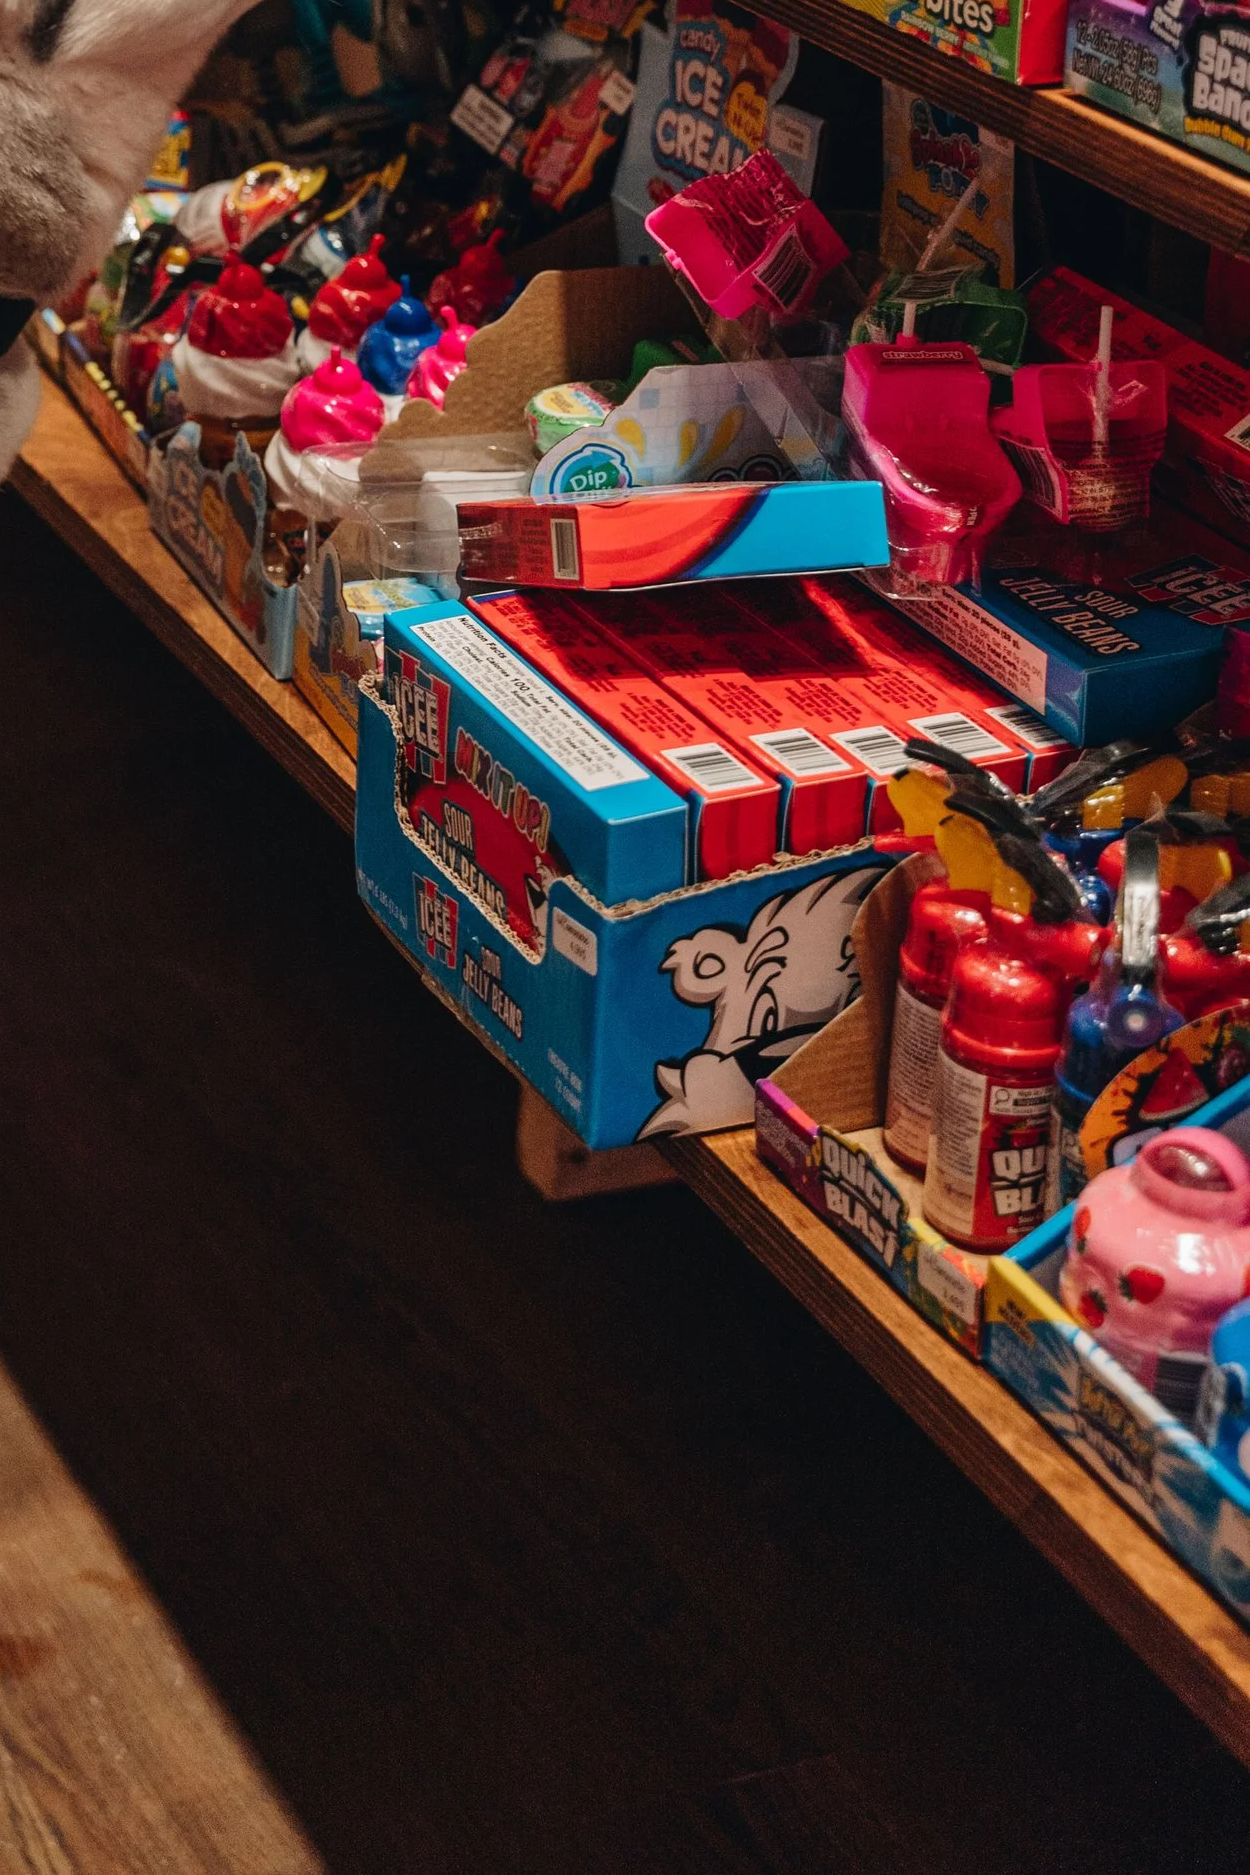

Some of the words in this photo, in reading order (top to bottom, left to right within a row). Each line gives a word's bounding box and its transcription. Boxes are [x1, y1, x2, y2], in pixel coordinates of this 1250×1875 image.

[680, 29, 721, 62] candy
[1198, 35, 1250, 91] Spa
[675, 59, 723, 119] ICE
[883, 351, 964, 360] strawberry
[570, 470, 607, 491] Dip
[1000, 576, 1078, 612] JELLY
[1051, 610, 1141, 654] BEANS
[1074, 590, 1139, 618] SOUR
[416, 625, 438, 641] Protein
[457, 617, 490, 642] Nutrition
[485, 642, 509, 658] Facts
[985, 642, 1002, 660] Total
[484, 656, 513, 677] Calories
[393, 671, 441, 757] ICEE
[453, 725, 493, 802] MIX
[492, 759, 516, 820] IT
[513, 780, 551, 855] UP!
[443, 801, 473, 853] SOUR
[419, 891, 452, 948] ICEE
[463, 954, 490, 1002] JELLY
[491, 985, 523, 1039] BEANS
[824, 1179, 896, 1269] BLAST
